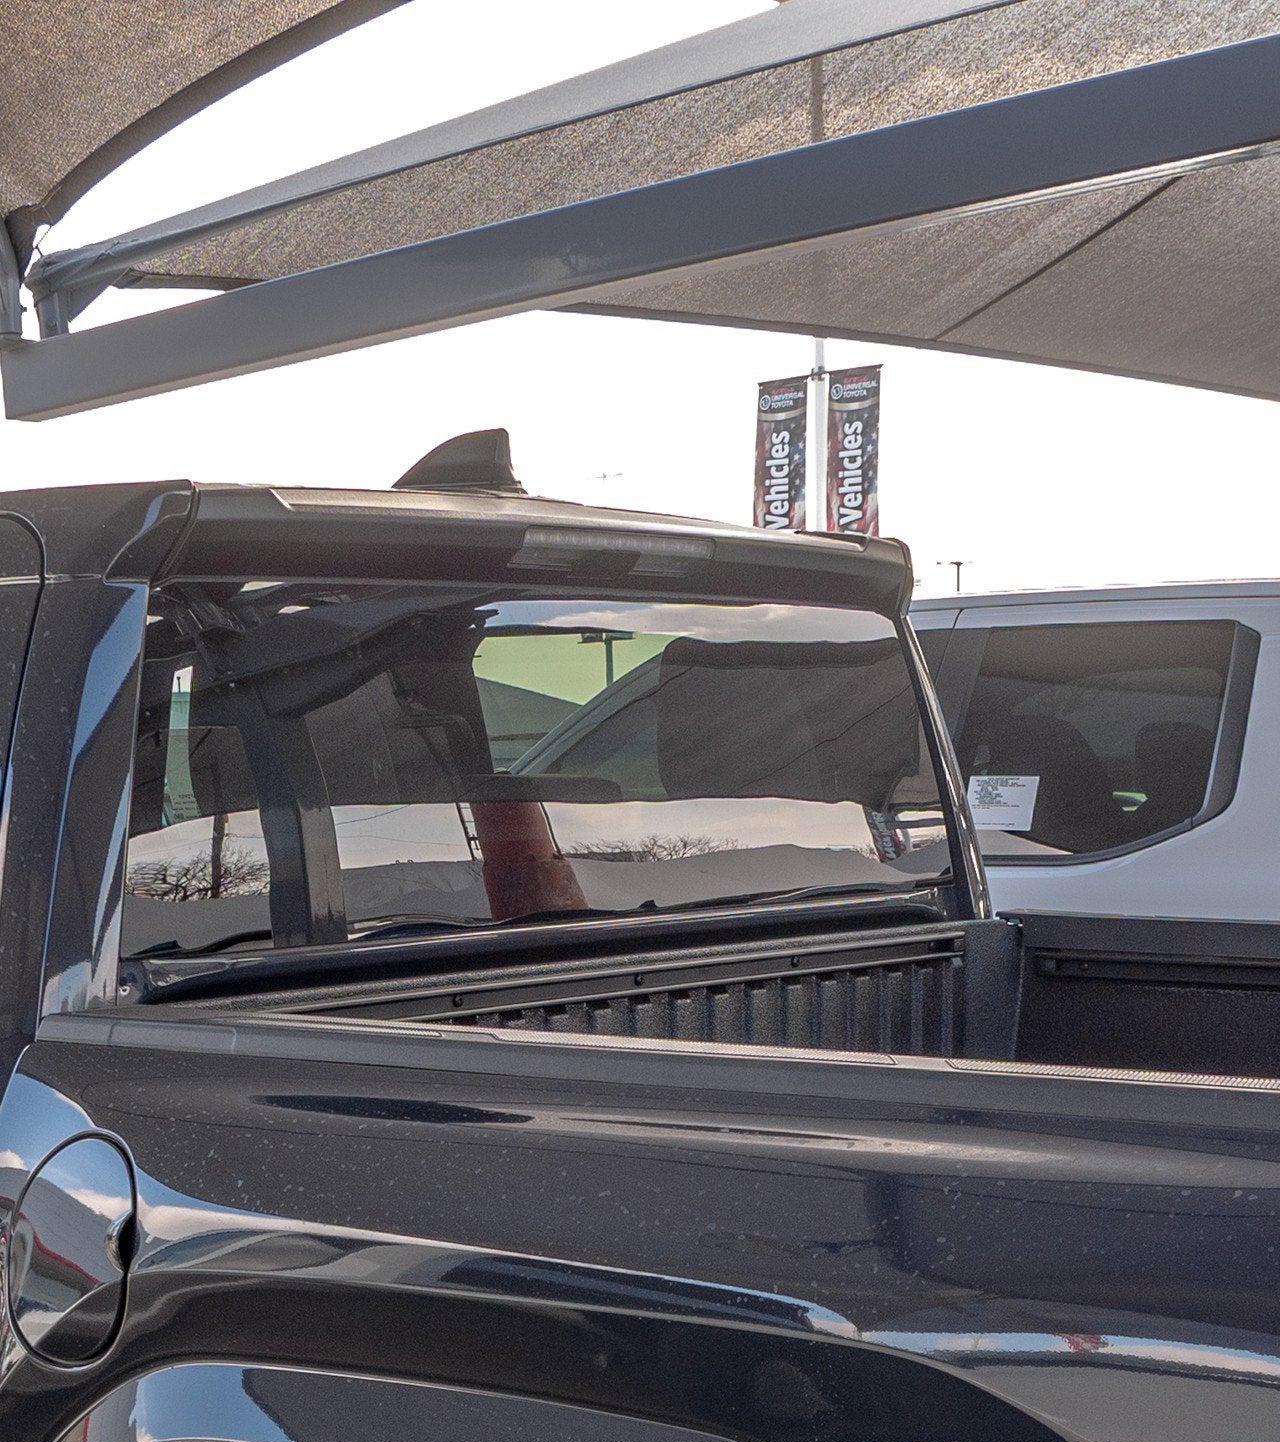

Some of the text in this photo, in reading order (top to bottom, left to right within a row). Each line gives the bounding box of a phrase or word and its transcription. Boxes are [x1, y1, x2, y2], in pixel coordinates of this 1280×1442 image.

[843, 380, 878, 391] UNIVERSAL
[771, 391, 805, 402] UNIVERSAL
[843, 389, 868, 399] TOYOTA
[771, 400, 794, 410] TOYOTA
[838, 420, 864, 526] Vehicles
[765, 429, 791, 530] Vehicles
